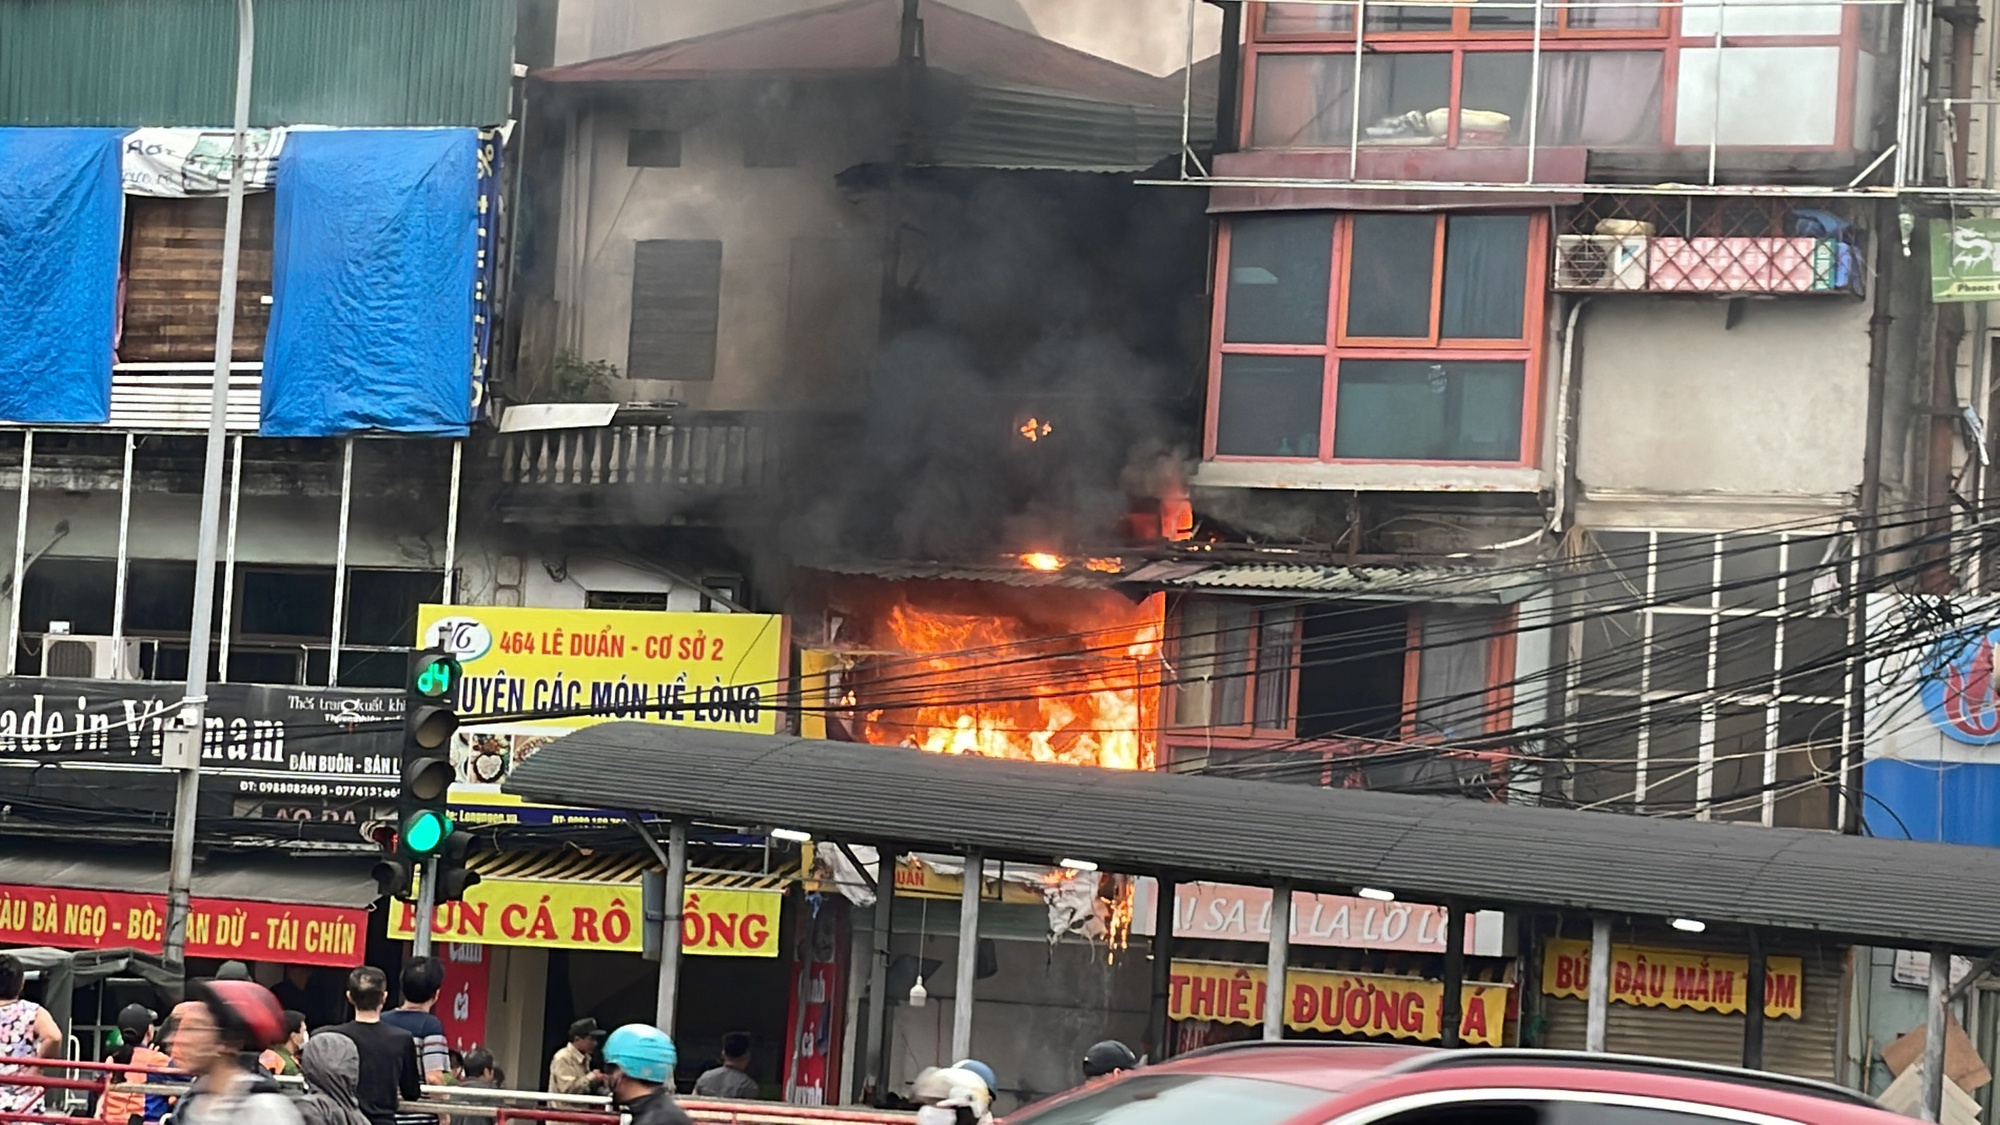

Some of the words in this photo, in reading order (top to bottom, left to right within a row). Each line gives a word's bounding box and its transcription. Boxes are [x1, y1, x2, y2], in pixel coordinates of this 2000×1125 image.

[500, 630, 535, 654] 464
[542, 627, 564, 656] LÊ
[570, 624, 625, 658] DUẨN
[645, 634, 673, 660] CƠ
[679, 629, 706, 661] SỞ
[711, 637, 724, 661] 2
[0, 694, 64, 752] ade
[75, 696, 109, 750] in
[461, 669, 525, 714] UYÊN
[533, 672, 582, 713] CÁC
[591, 675, 648, 719] MÓN
[658, 672, 686, 721] VỀ
[694, 676, 760, 724] LÒNG
[318, 752, 354, 773] BUÔN
[393, 758, 400, 774] L
[0, 891, 27, 931] ÀU
[32, 895, 58, 934] BÀ
[64, 904, 107, 944] NGỌ
[215, 907, 247, 948] DỪ
[266, 911, 299, 951] TÁI
[304, 915, 356, 955] CHÍN
[500, 894, 558, 941] CÁ
[572, 899, 631, 944] RÔ
[681, 893, 770, 949] ỒNG
[1203, 898, 1247, 933] SA
[1309, 903, 1350, 939] LA
[1292, 977, 1424, 1033] ĐƯỜNG
[1615, 955, 1667, 1003] ĐẬU
